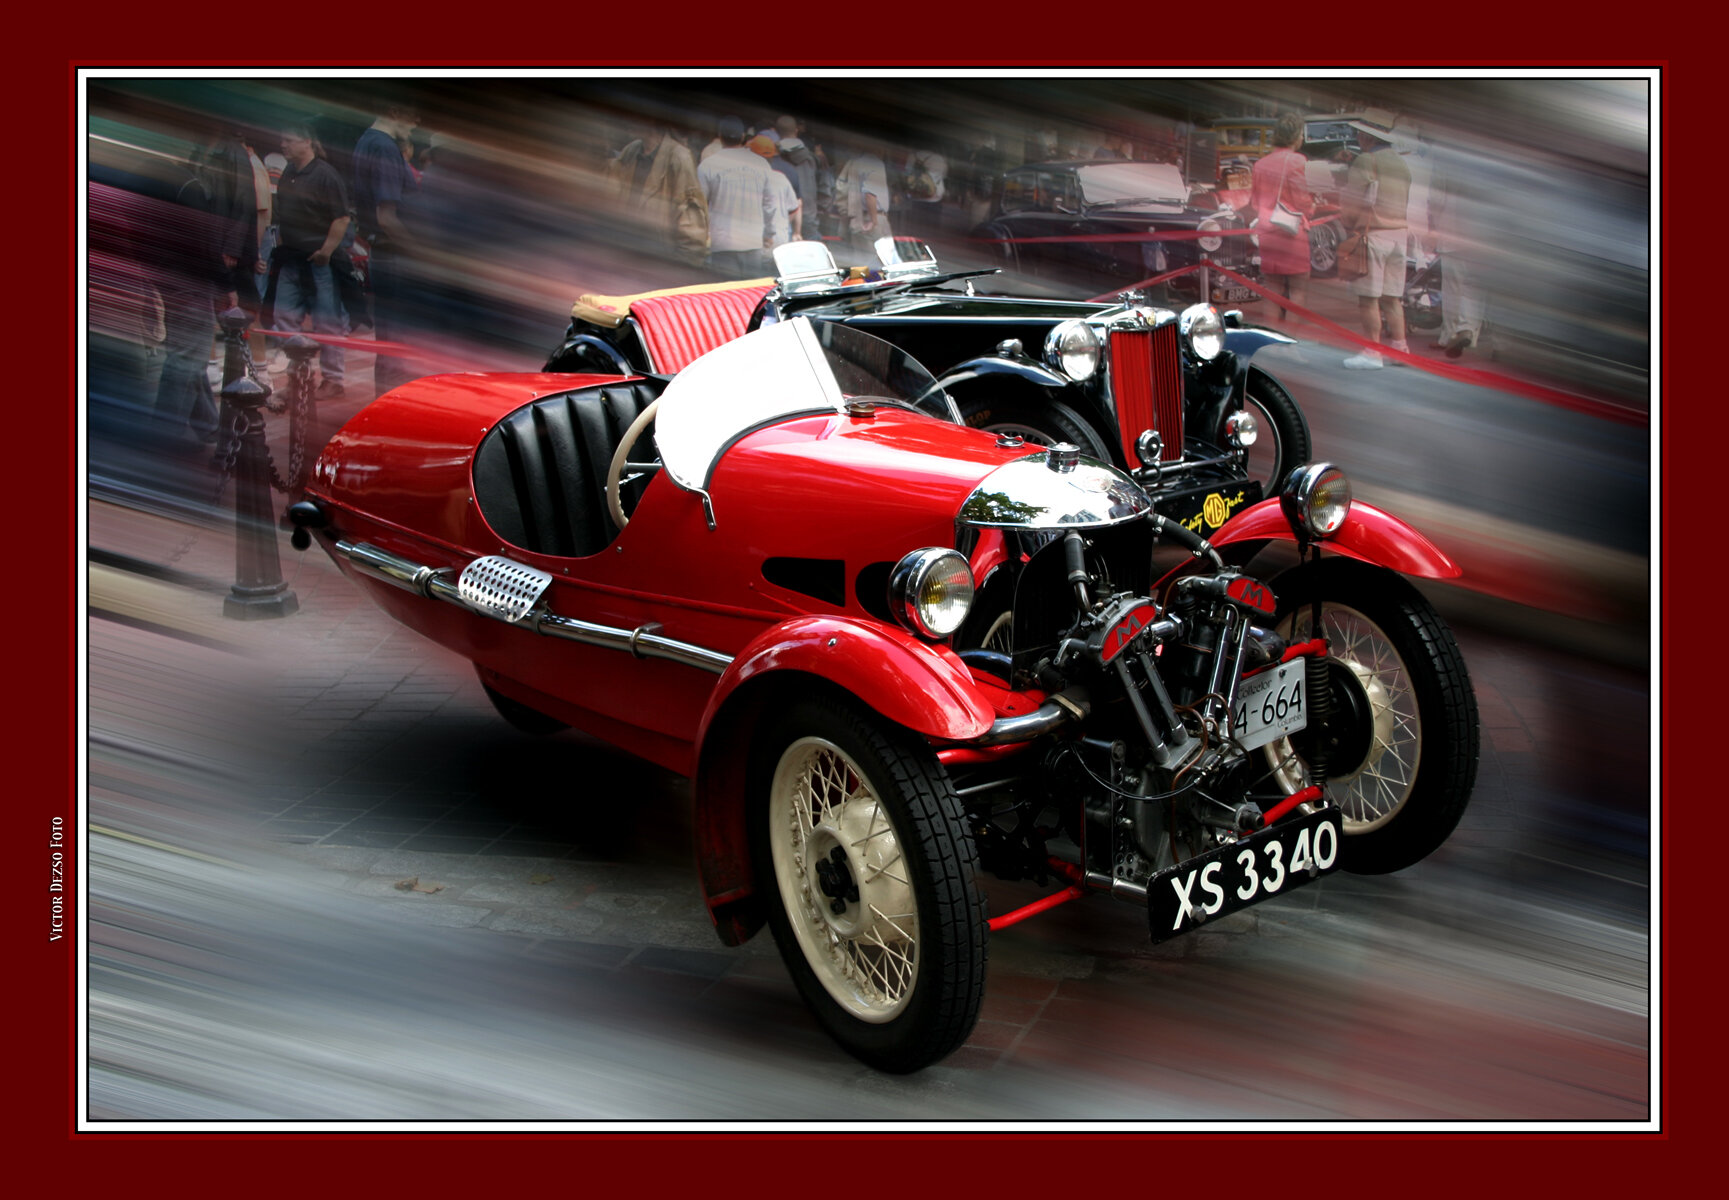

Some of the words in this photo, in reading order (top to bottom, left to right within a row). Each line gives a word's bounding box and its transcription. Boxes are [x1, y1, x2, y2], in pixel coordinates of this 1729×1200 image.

[1205, 496, 1224, 525] MG
[1241, 582, 1263, 607] M
[1116, 615, 1142, 647] M
[1237, 679, 1273, 701] Collector
[1170, 861, 1224, 931] XS
[1236, 820, 1338, 901] 3340
